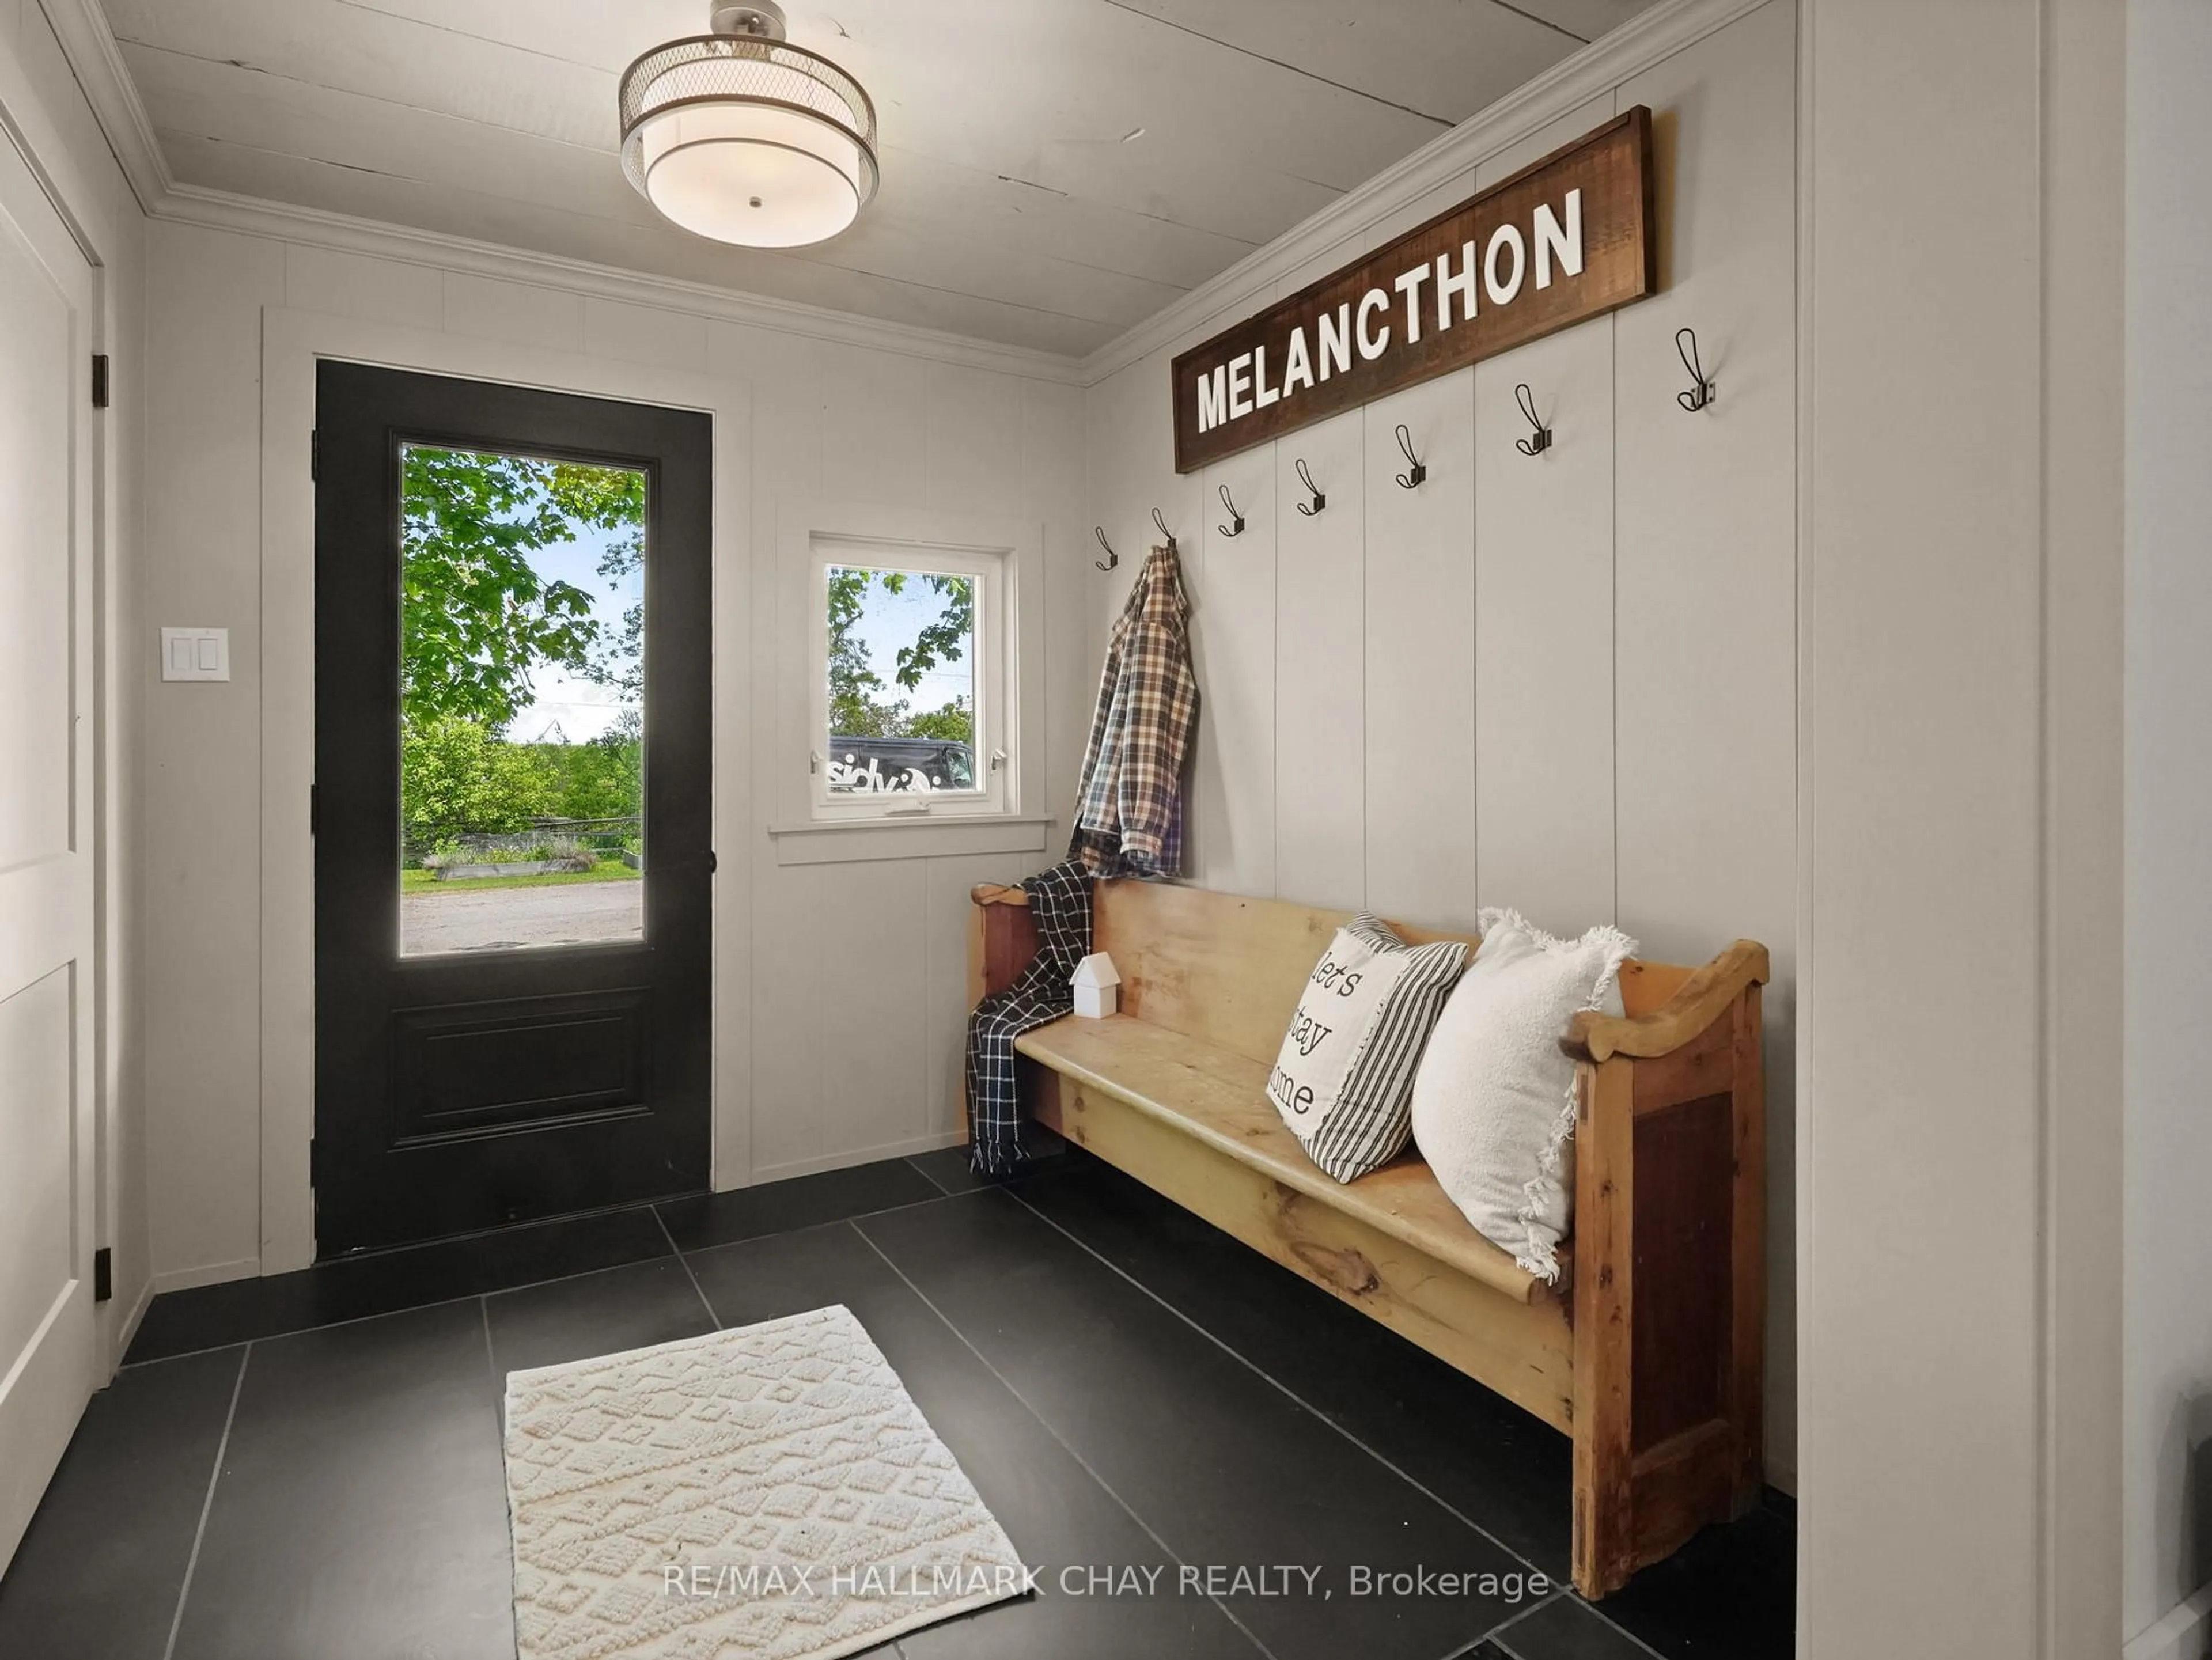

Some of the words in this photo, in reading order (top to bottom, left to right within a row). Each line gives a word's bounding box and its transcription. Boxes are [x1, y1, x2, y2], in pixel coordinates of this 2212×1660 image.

[1198, 188, 1584, 433] MELANCTHON
[1289, 1006, 1332, 1056] tay
[1270, 1066, 1313, 1115] ome
